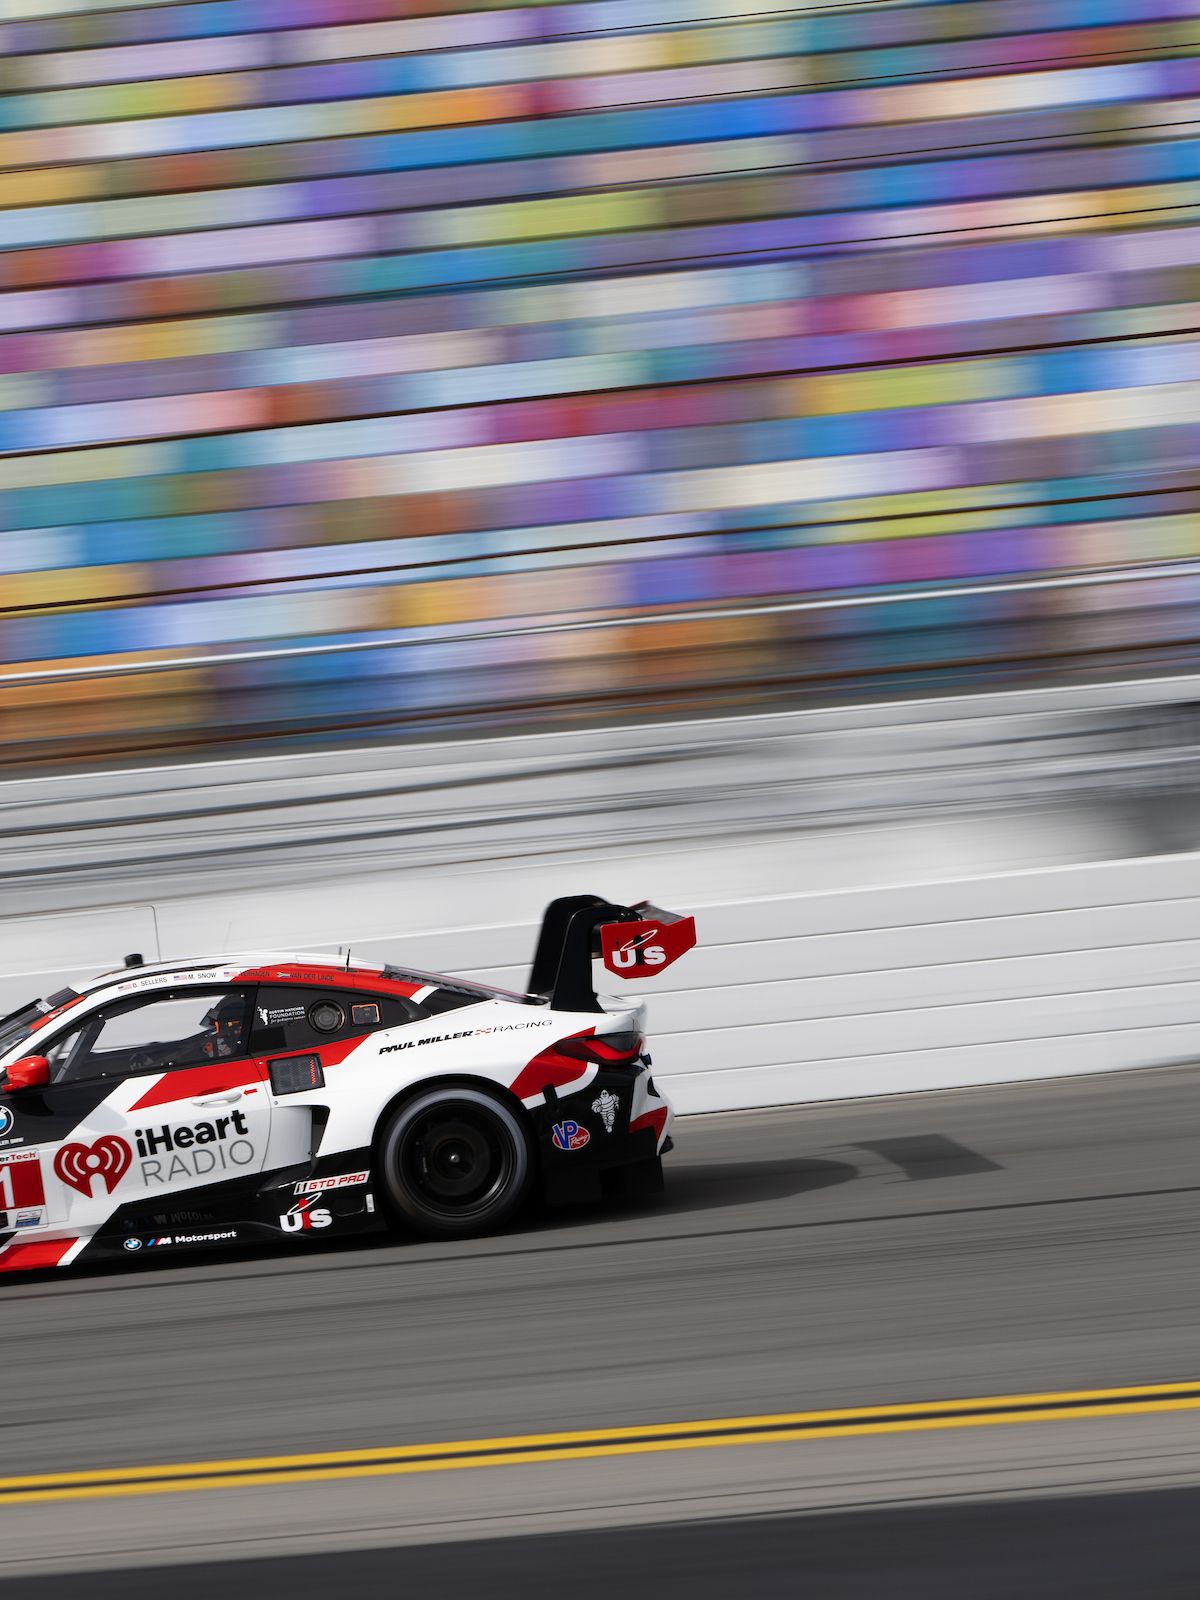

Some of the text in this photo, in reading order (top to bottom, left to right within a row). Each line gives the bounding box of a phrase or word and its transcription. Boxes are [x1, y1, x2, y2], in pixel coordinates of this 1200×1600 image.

[141, 977, 167, 987] SELLERS
[269, 1011, 305, 1019] FOUNDATION
[379, 1020, 553, 1055] PAUL MILLER RACING
[135, 1110, 248, 1158] iHeart
[552, 1120, 578, 1149] VP
[141, 1139, 254, 1187] RADIO
[175, 1230, 237, 1244] Motorsport
